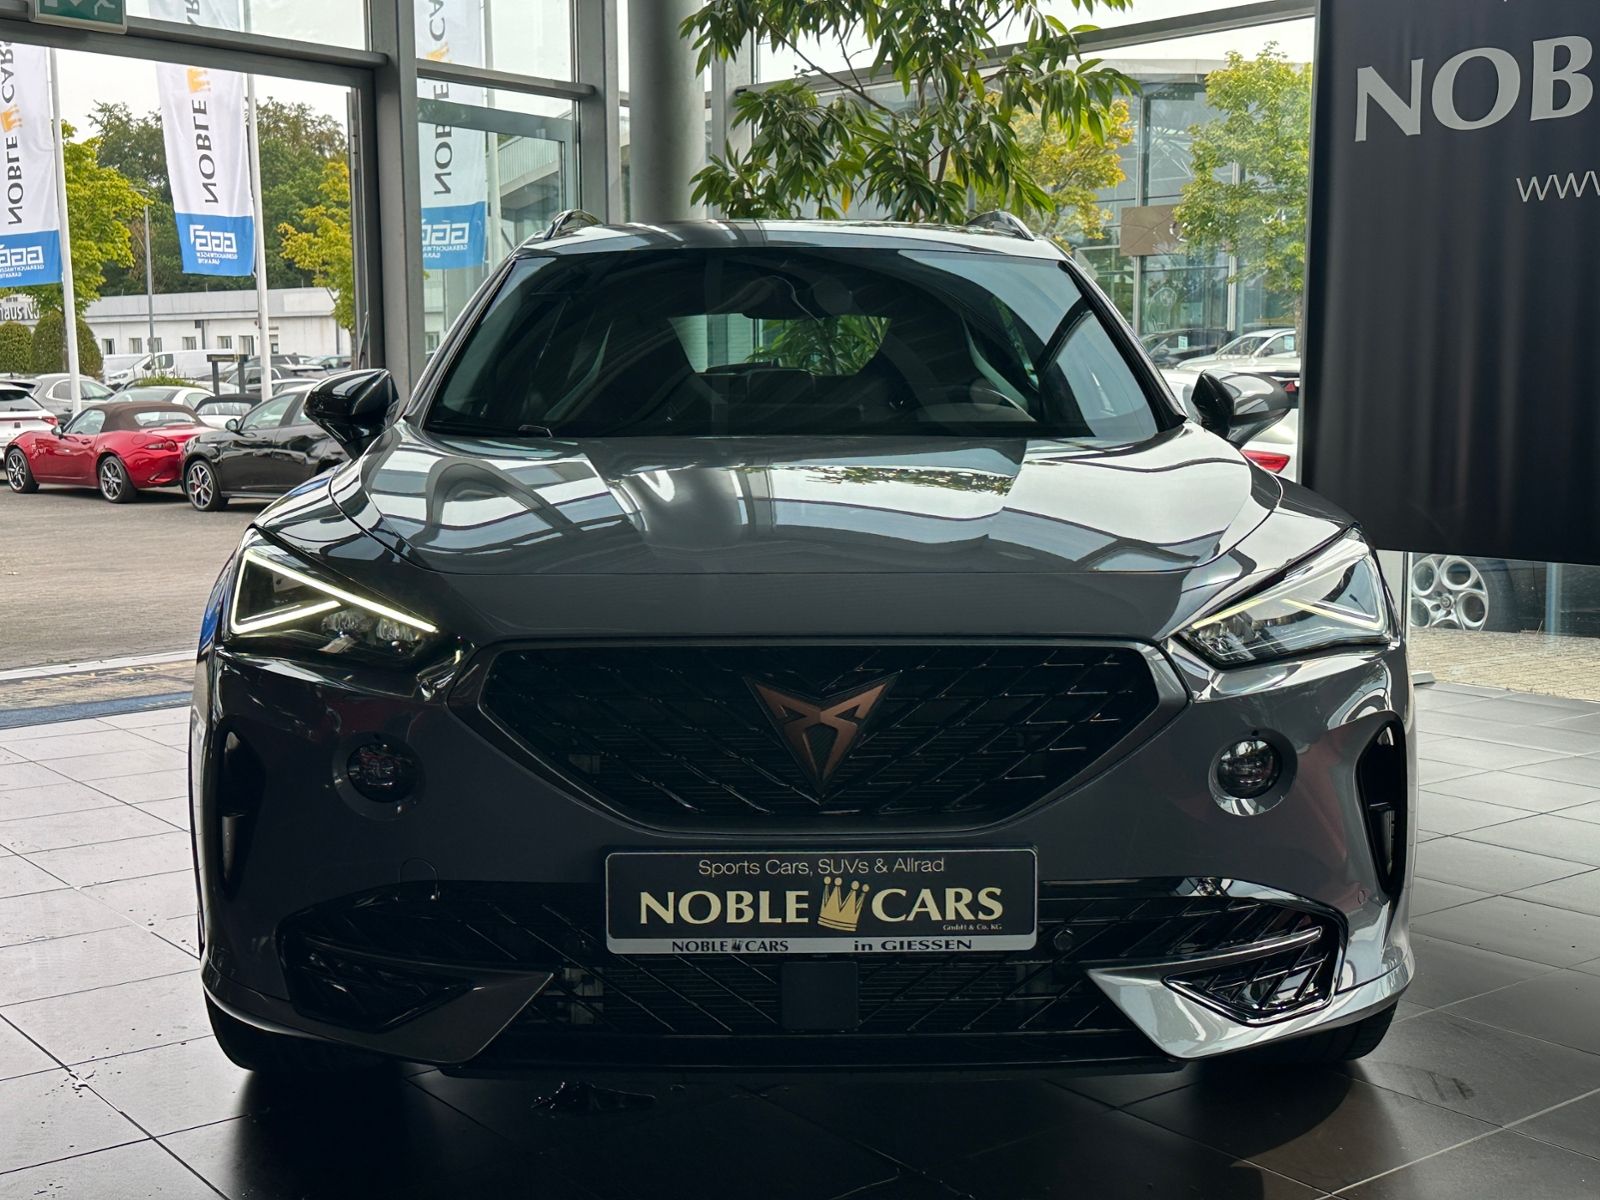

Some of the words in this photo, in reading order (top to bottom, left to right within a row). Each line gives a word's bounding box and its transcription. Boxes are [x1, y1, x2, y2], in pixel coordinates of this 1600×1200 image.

[1354, 35, 1594, 142] NOB
[1515, 170, 1600, 203] ww
[698, 859, 760, 877] Sports
[765, 859, 813, 877] Cars,
[817, 858, 869, 874] SUVs
[874, 858, 888, 874] &
[893, 857, 945, 873] Allrad
[639, 889, 809, 924] NOBLE
[871, 887, 1004, 922] CARS
[672, 940, 728, 953] NOBLE
[744, 940, 789, 952] CARS
[854, 940, 873, 951] in
[880, 939, 972, 951] GIESSEN
